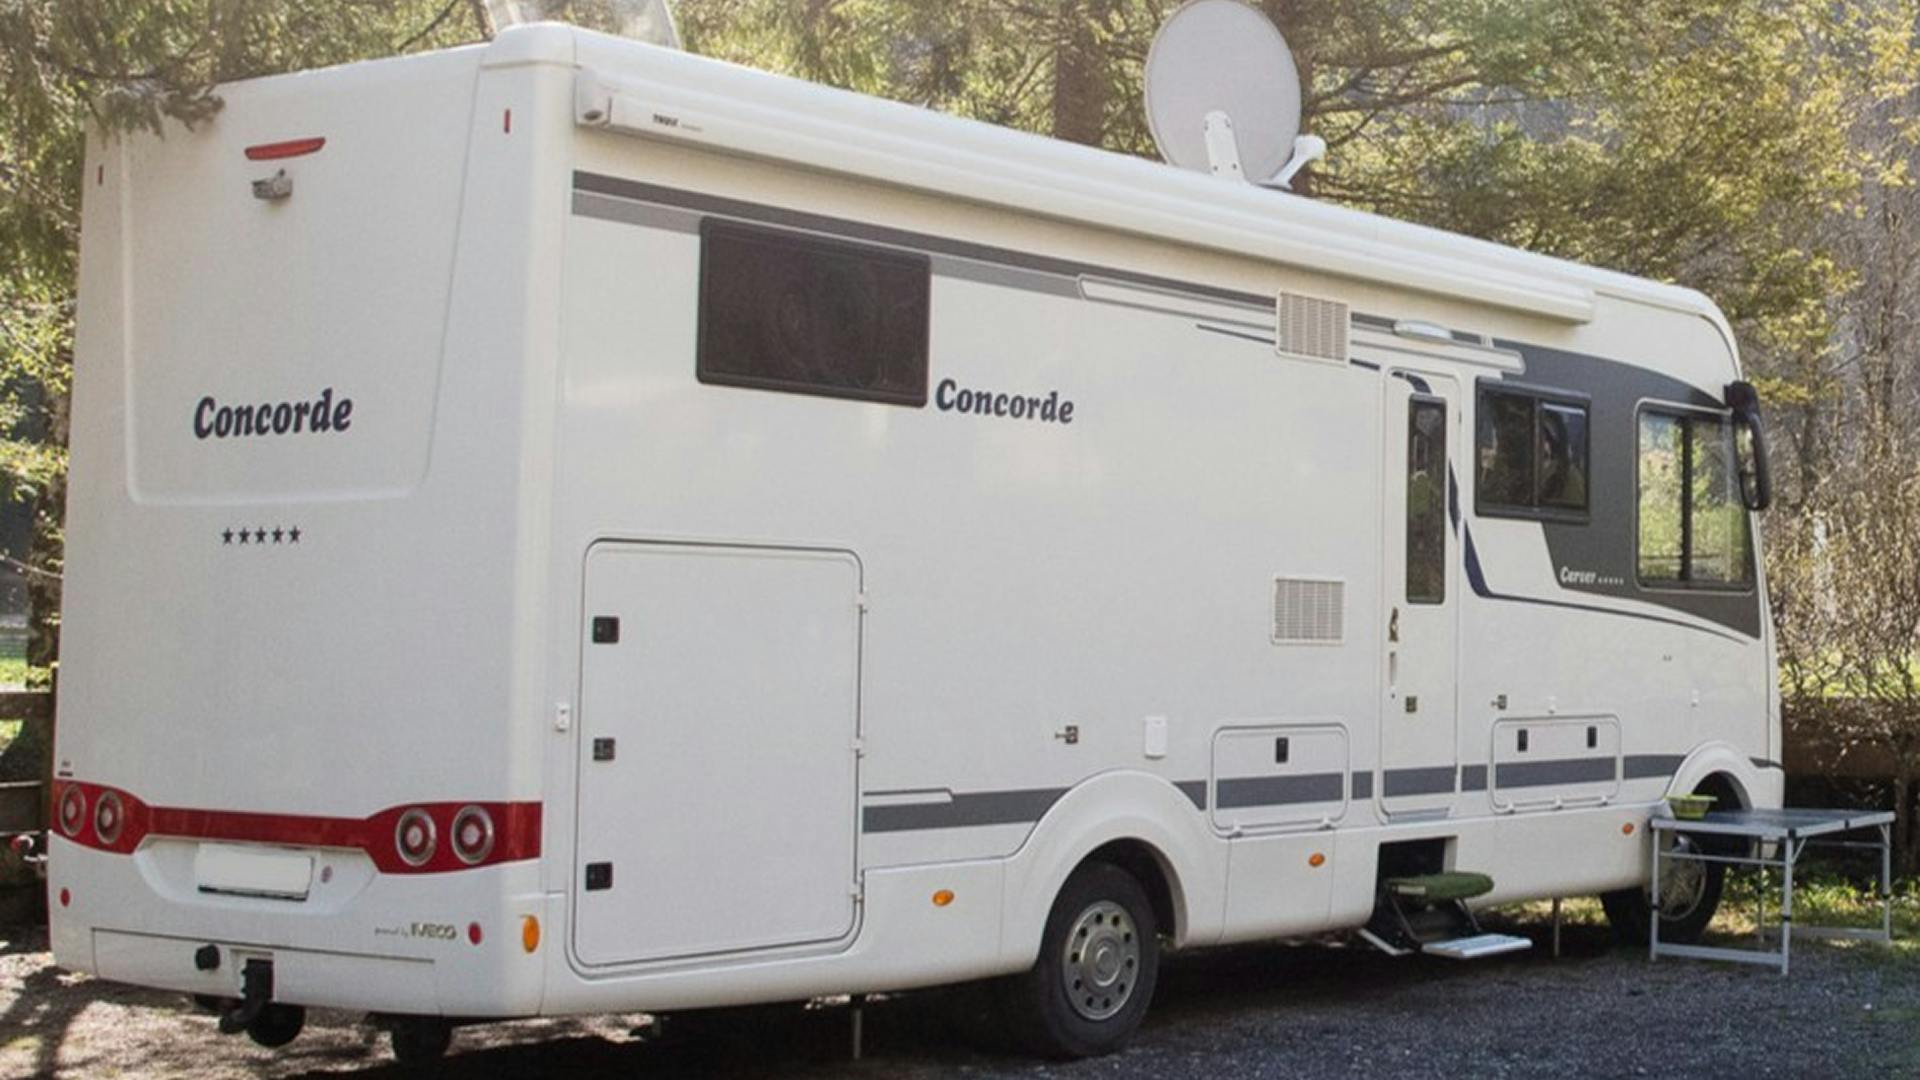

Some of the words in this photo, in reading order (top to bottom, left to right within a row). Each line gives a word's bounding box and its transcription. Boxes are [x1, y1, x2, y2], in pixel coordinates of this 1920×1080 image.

[193, 387, 353, 440] Concorde
[935, 377, 1075, 425] Concorde
[411, 922, 457, 940] IVECO
